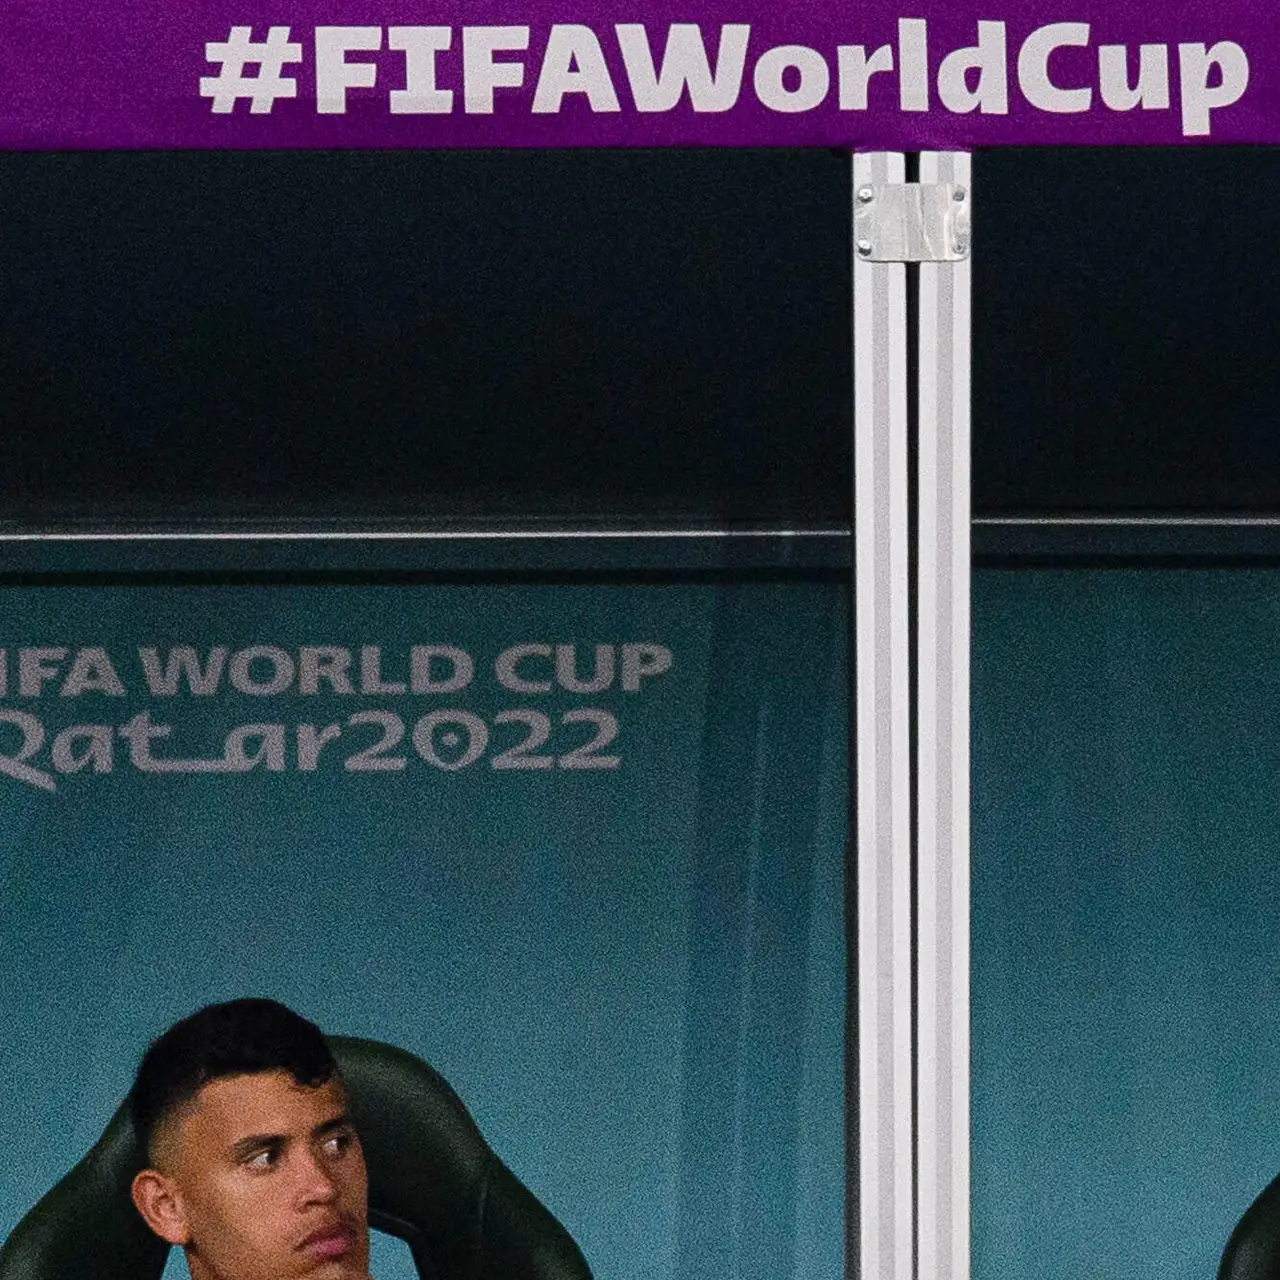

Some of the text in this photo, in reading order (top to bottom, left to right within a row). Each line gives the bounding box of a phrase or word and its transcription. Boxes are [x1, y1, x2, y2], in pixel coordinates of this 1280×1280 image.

[198, 17, 1250, 137] #FIFAWorldCup
[0, 643, 673, 697] FA WORLD CUP
